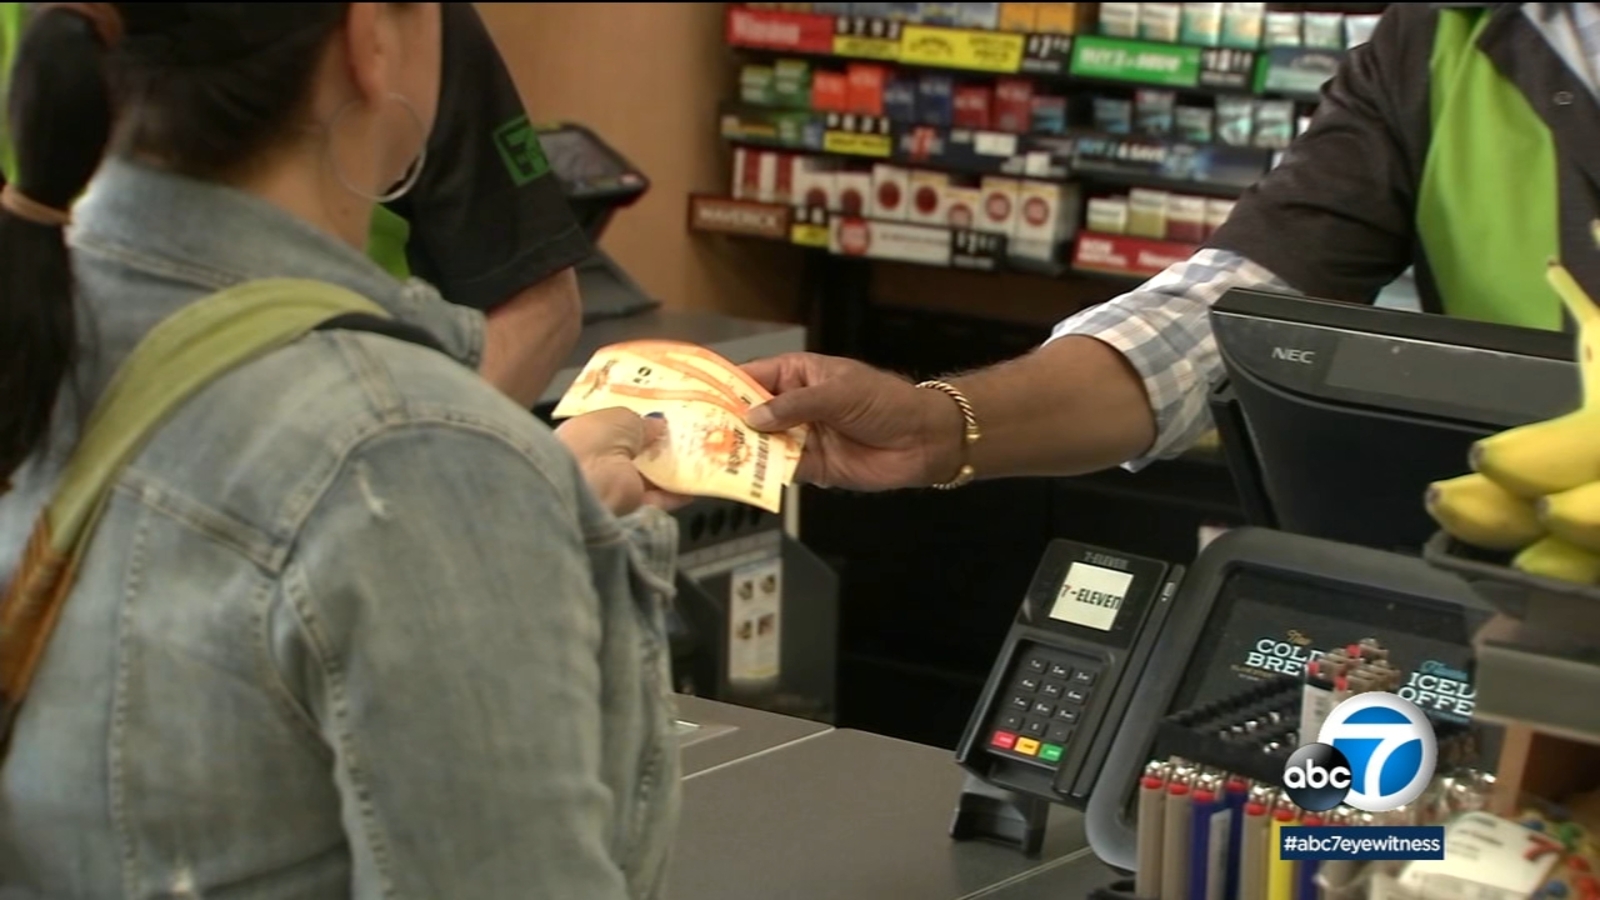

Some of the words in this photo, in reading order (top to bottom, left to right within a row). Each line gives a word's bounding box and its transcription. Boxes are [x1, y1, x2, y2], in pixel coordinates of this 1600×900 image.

[1271, 347, 1315, 364] NEC
[1245, 651, 1307, 677] BRE
[1398, 687, 1476, 716] OFFE
